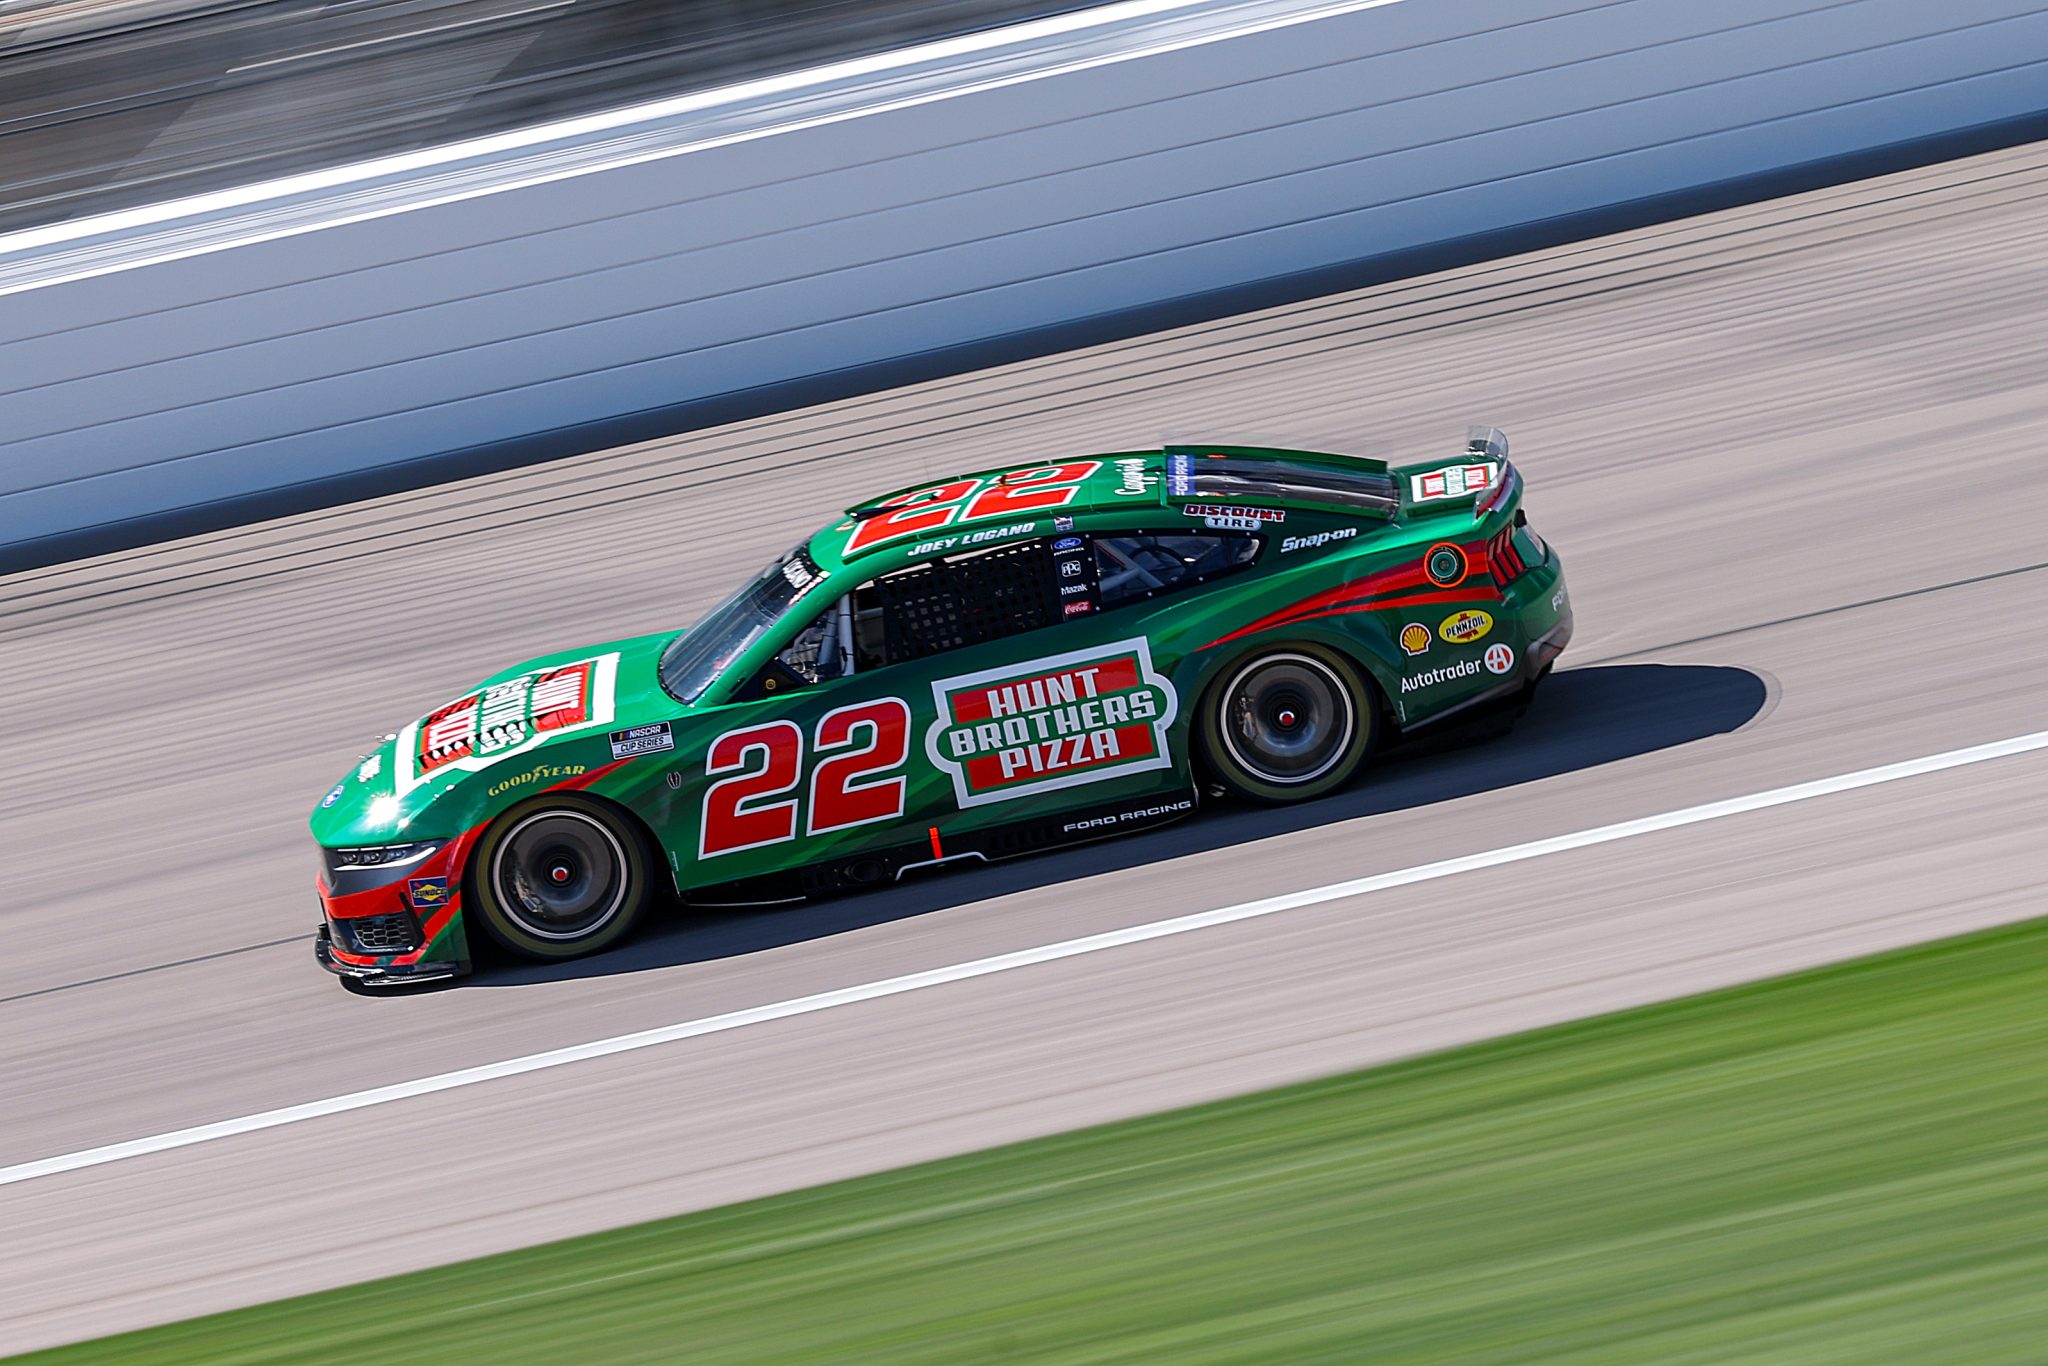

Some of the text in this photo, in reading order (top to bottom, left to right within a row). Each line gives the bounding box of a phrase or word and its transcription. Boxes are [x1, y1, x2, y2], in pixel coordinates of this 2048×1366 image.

[840, 460, 1104, 557] 22
[1184, 504, 1285, 522] DISCOUNT
[1212, 518, 1255, 528] TIRE
[907, 537, 958, 557] JOEY
[961, 522, 1035, 545] LOGANO
[1280, 527, 1357, 553] Snap-on
[1062, 562, 1080, 575] PPG
[1060, 583, 1088, 596] Mazak
[1446, 615, 1485, 638] PENNZOIL
[1401, 659, 1481, 693] Autotrader
[986, 668, 1100, 719] HUNT
[629, 725, 661, 738] NASCAR
[949, 690, 1156, 757] BROTHERS
[620, 737, 664, 752] CUP SERIES
[998, 728, 1121, 779] PIZZA
[488, 765, 585, 796] GOODYEAR
[698, 696, 912, 861] 22
[1063, 800, 1191, 832] FORD RACING
